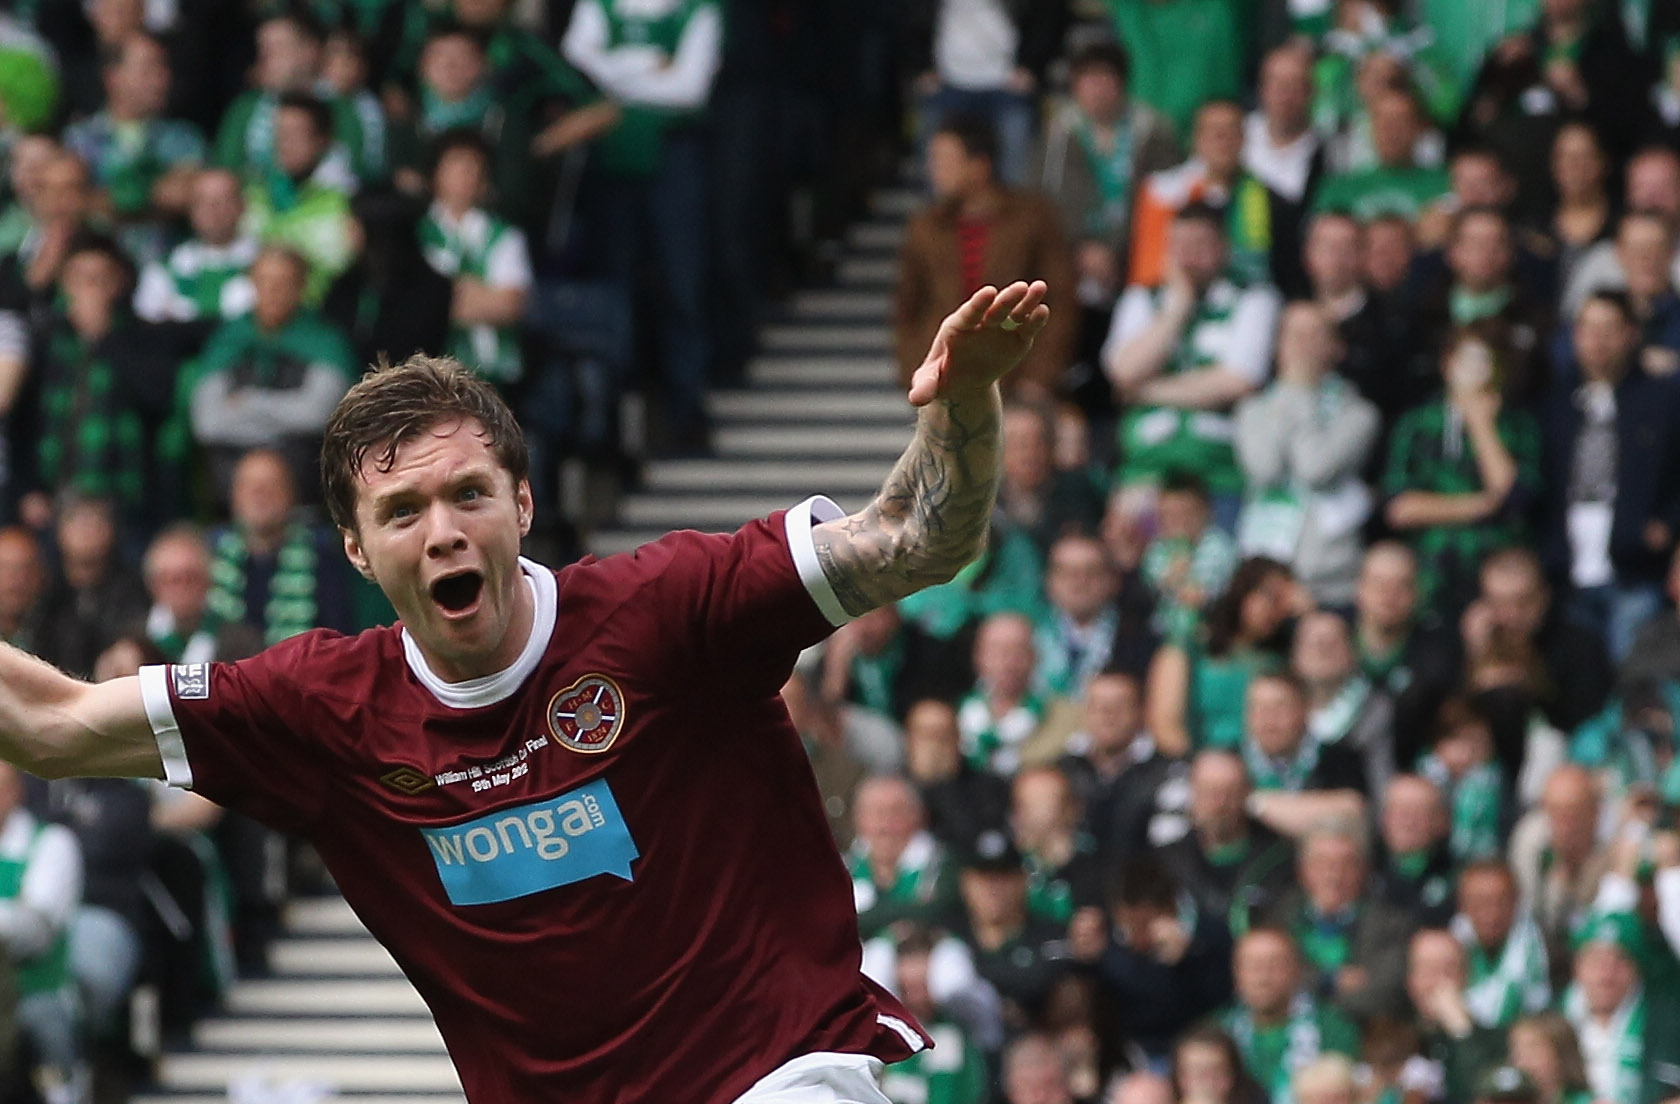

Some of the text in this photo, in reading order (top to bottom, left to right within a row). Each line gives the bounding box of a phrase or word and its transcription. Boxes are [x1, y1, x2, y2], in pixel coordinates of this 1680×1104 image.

[435, 770, 468, 787] William
[524, 734, 549, 753] Final
[427, 800, 593, 867] wonga
